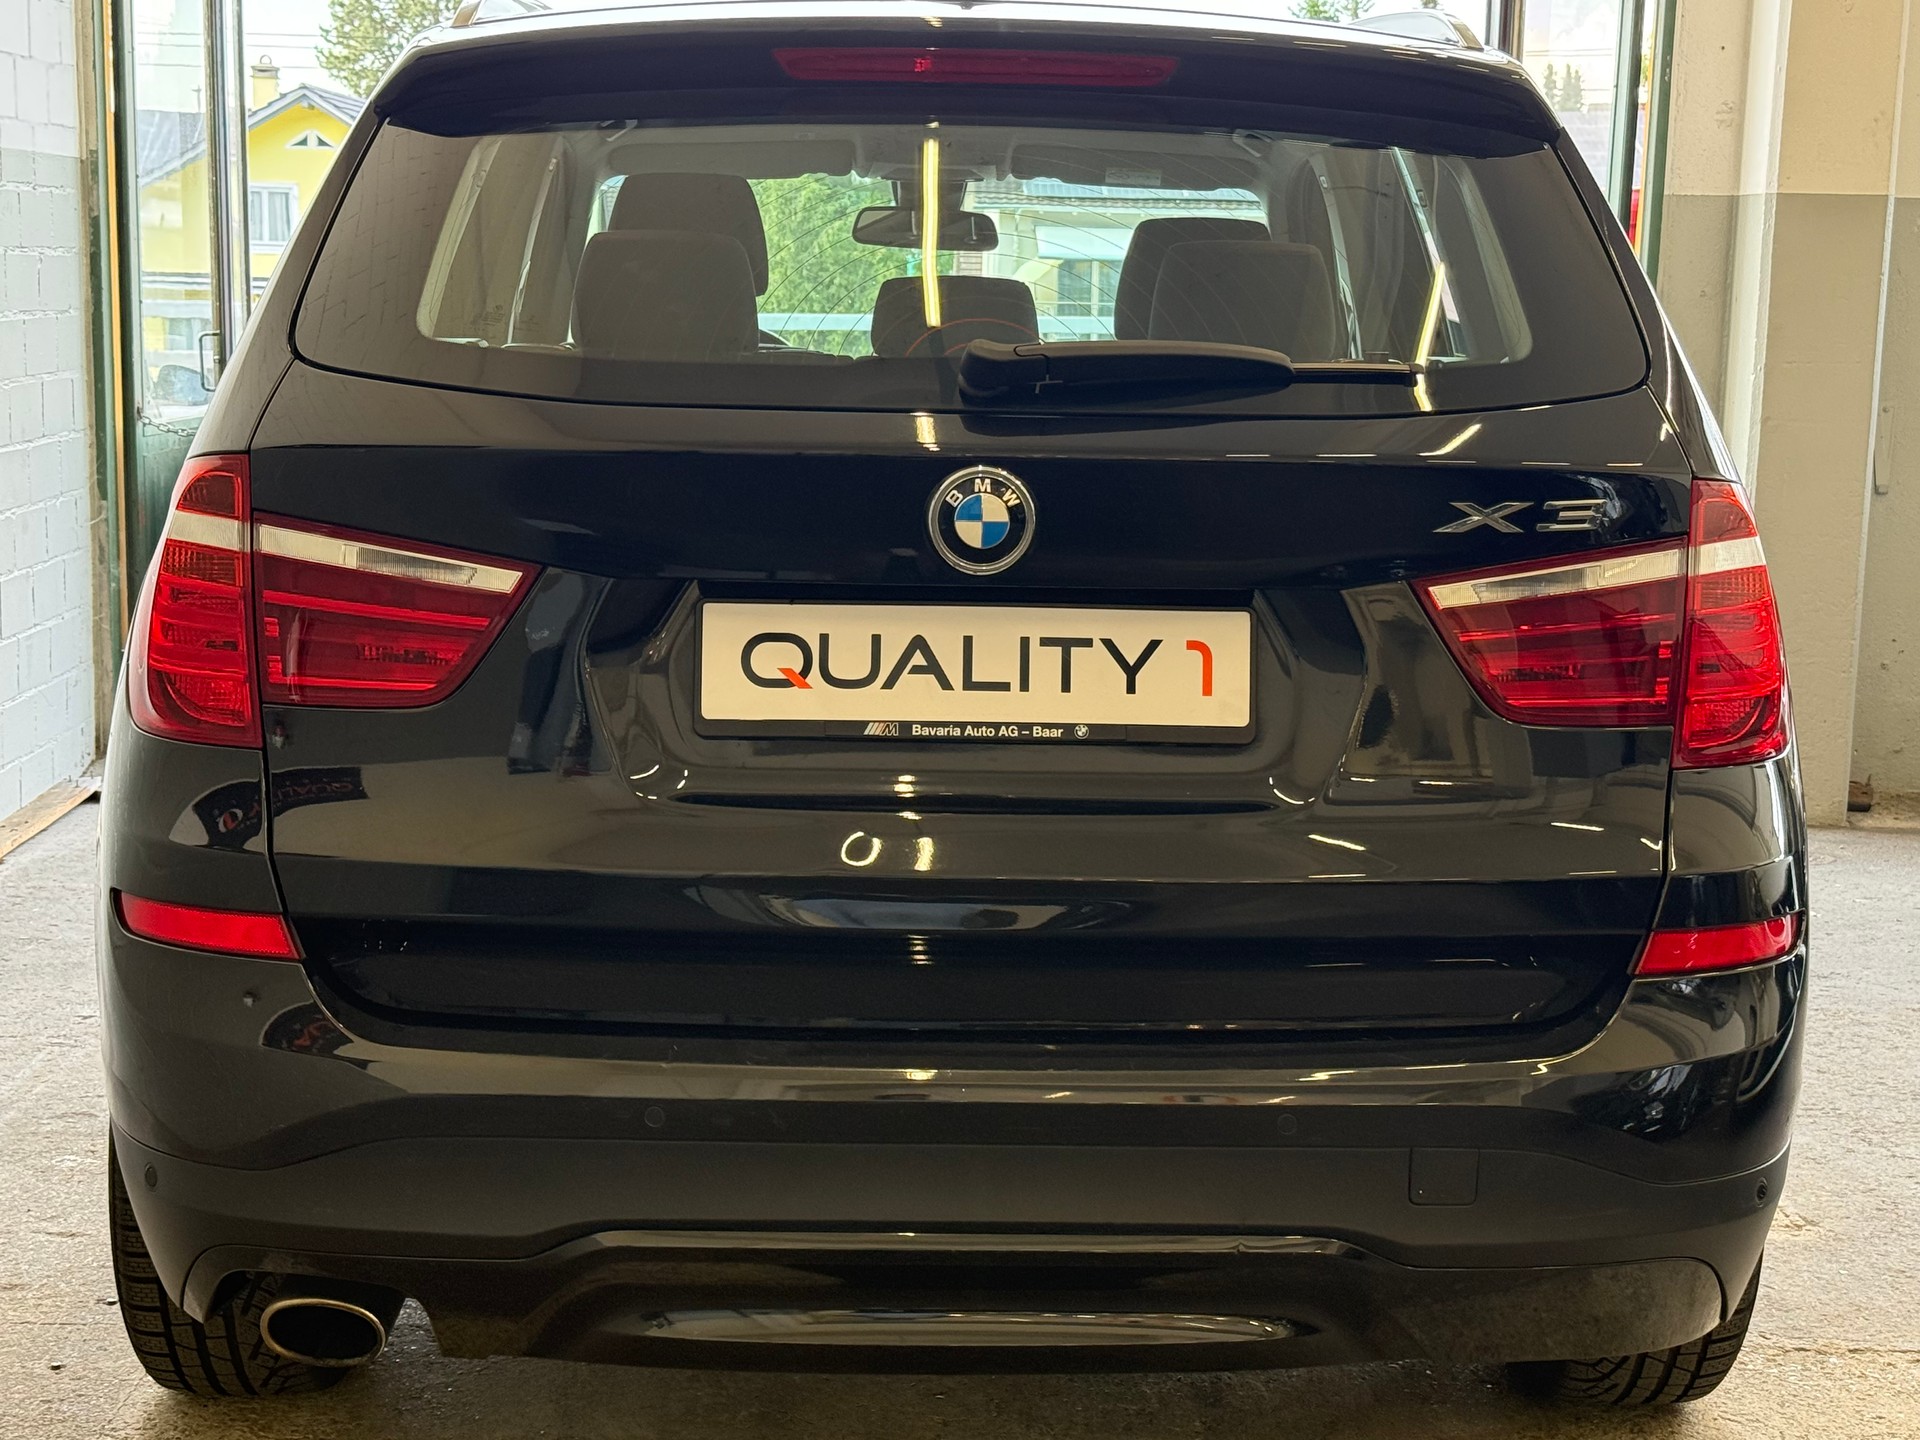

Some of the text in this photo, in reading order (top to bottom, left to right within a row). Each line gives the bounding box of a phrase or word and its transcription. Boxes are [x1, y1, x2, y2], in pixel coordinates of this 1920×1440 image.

[945, 478, 1021, 507] BMW
[1432, 499, 1607, 533] X3
[740, 632, 1213, 696] QUALITY 1
[911, 724, 961, 737] Bavaria
[963, 725, 995, 737] Auto
[998, 725, 1019, 737] AG
[1032, 726, 1064, 738] Baar
